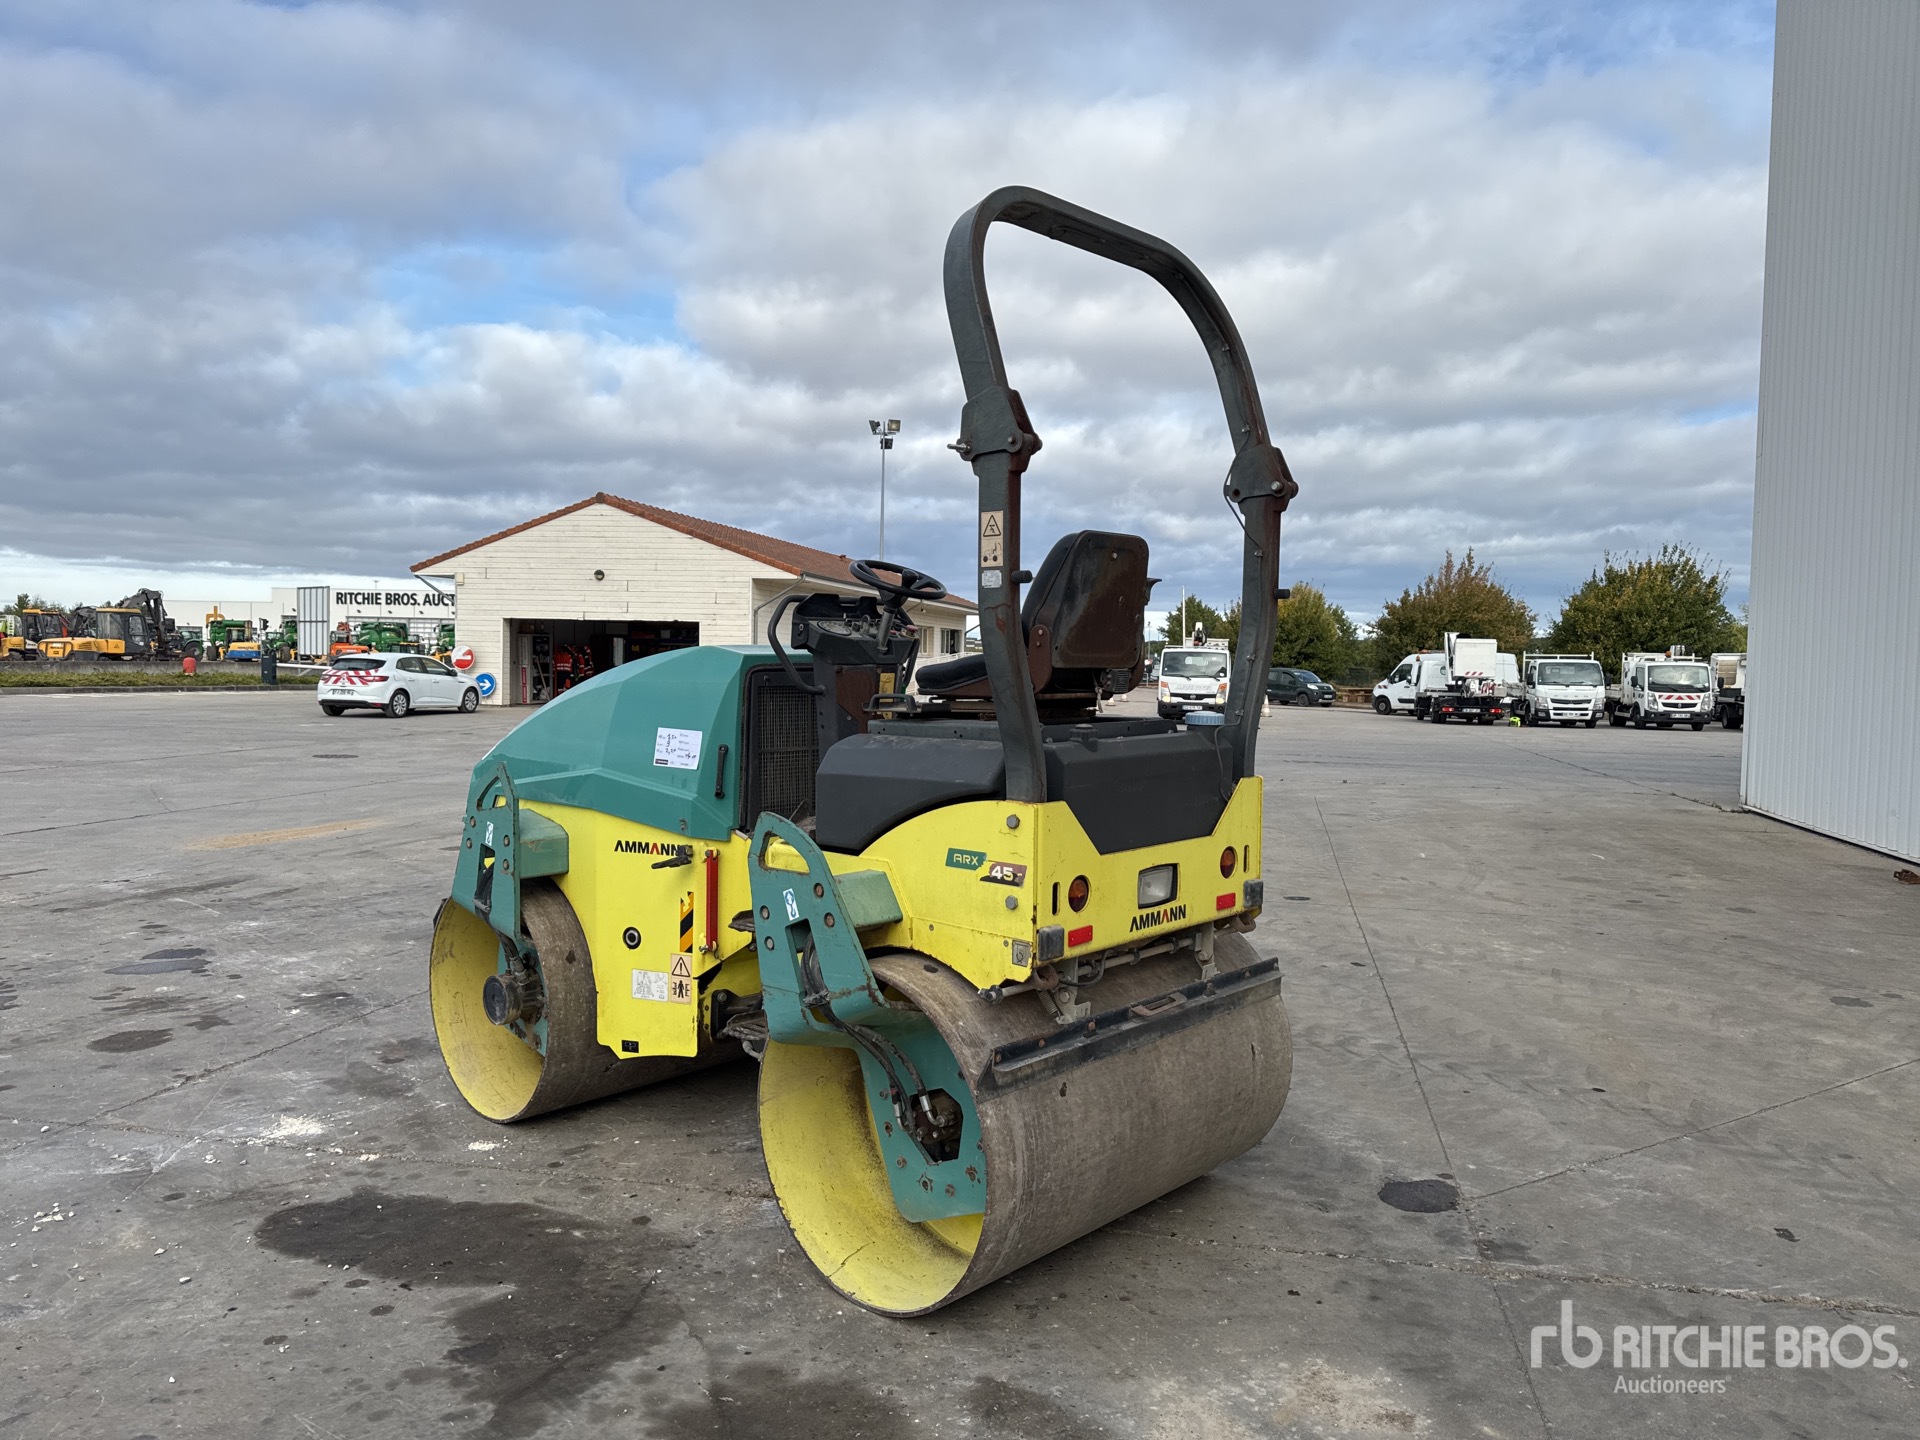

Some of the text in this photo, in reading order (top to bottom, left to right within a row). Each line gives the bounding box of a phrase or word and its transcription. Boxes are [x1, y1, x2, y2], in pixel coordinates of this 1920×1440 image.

[336, 592, 382, 605] RITCHIE
[385, 593, 421, 606] BROS.
[953, 853, 979, 866] ARX
[991, 865, 1014, 881] 45
[1130, 904, 1187, 932] AMMANN
